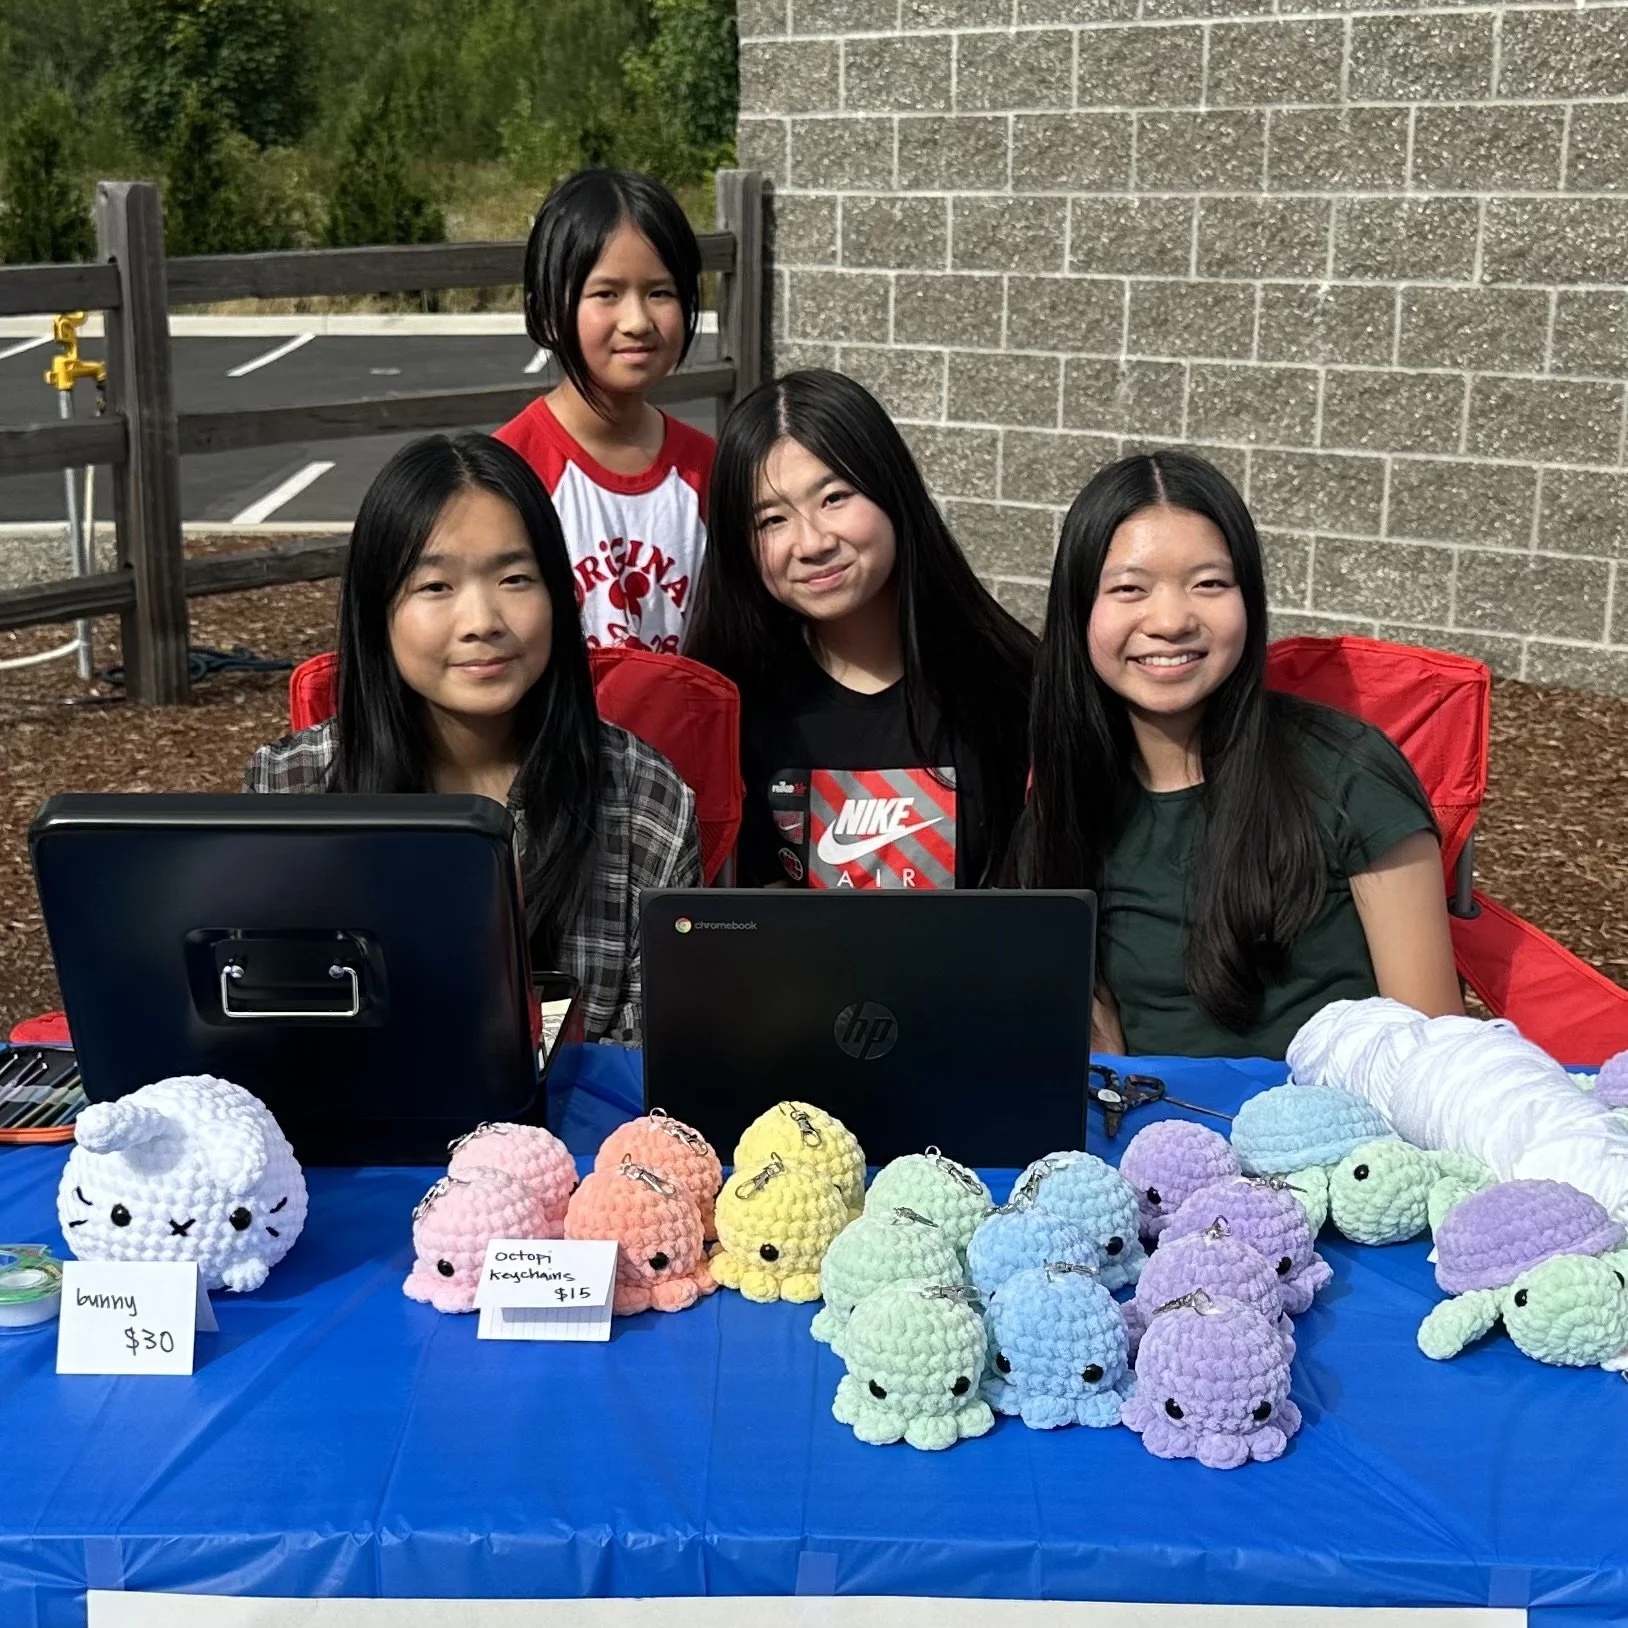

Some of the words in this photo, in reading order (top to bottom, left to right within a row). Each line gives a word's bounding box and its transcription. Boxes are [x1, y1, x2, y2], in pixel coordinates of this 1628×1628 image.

[834, 797, 915, 835] NIKE
[837, 868, 916, 888] AIR
[694, 920, 758, 930] chromebook
[76, 1287, 138, 1317] bunny
[554, 1286, 592, 1303] $15
[124, 1326, 175, 1357] $30
